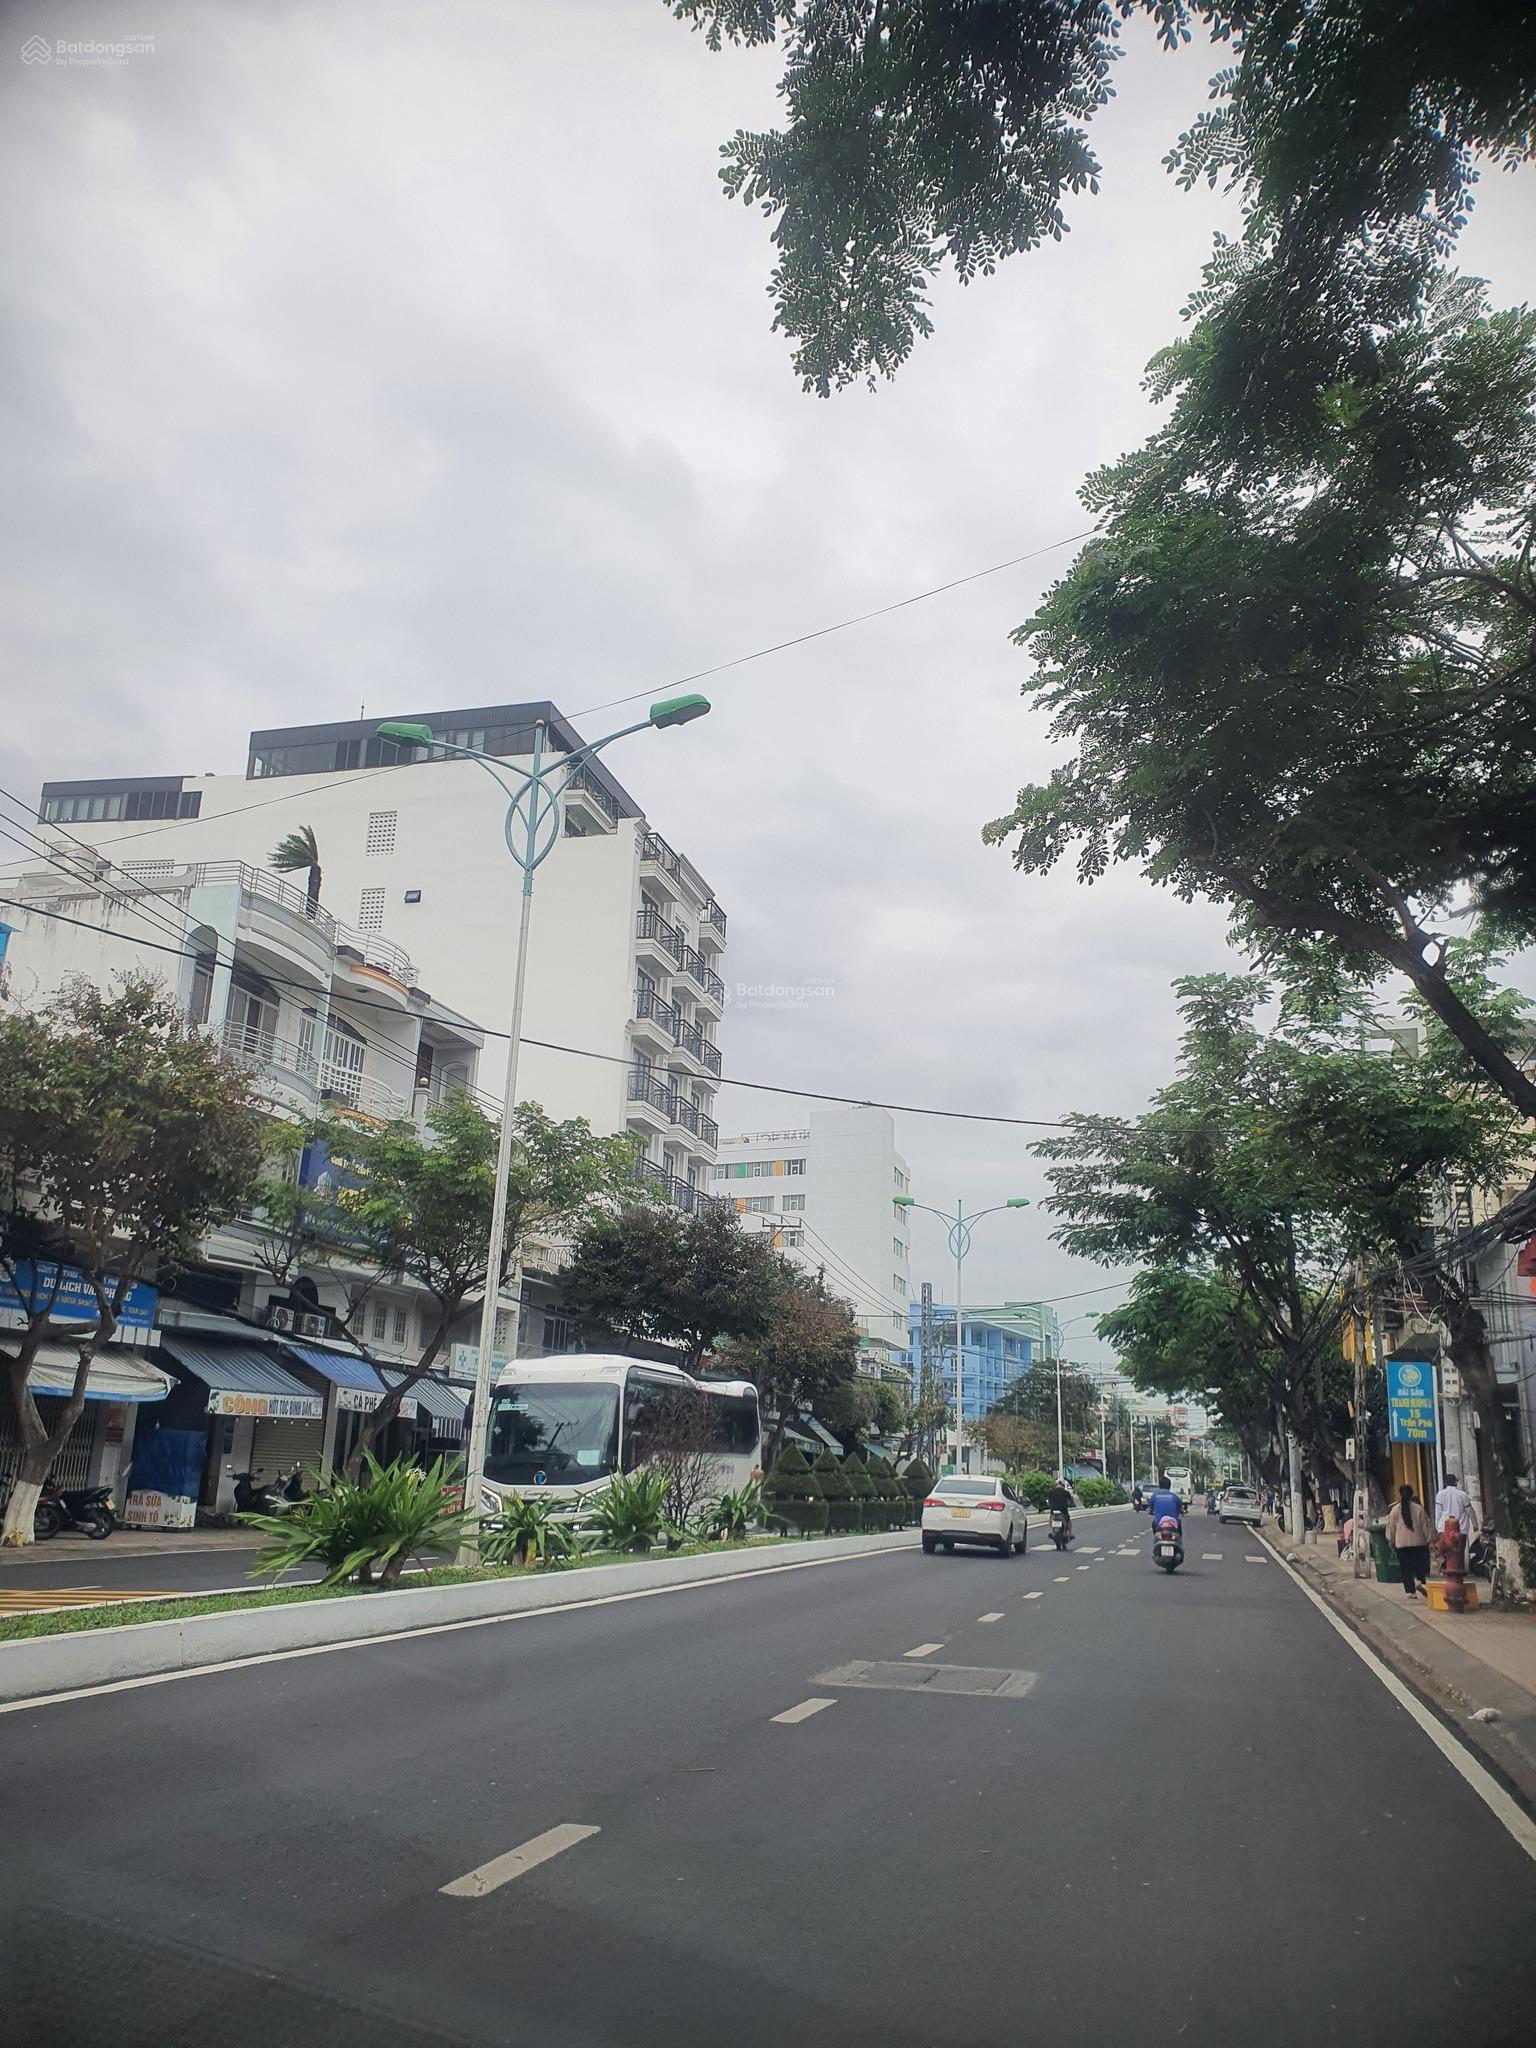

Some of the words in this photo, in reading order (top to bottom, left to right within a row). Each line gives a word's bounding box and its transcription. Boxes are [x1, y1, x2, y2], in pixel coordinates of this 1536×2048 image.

[43, 1277, 57, 1289] DU
[59, 1281, 82, 1294] LỊCH
[103, 1287, 132, 1302] PHG
[1410, 1409, 1421, 1419] 15
[1407, 1427, 1427, 1438] 70m
